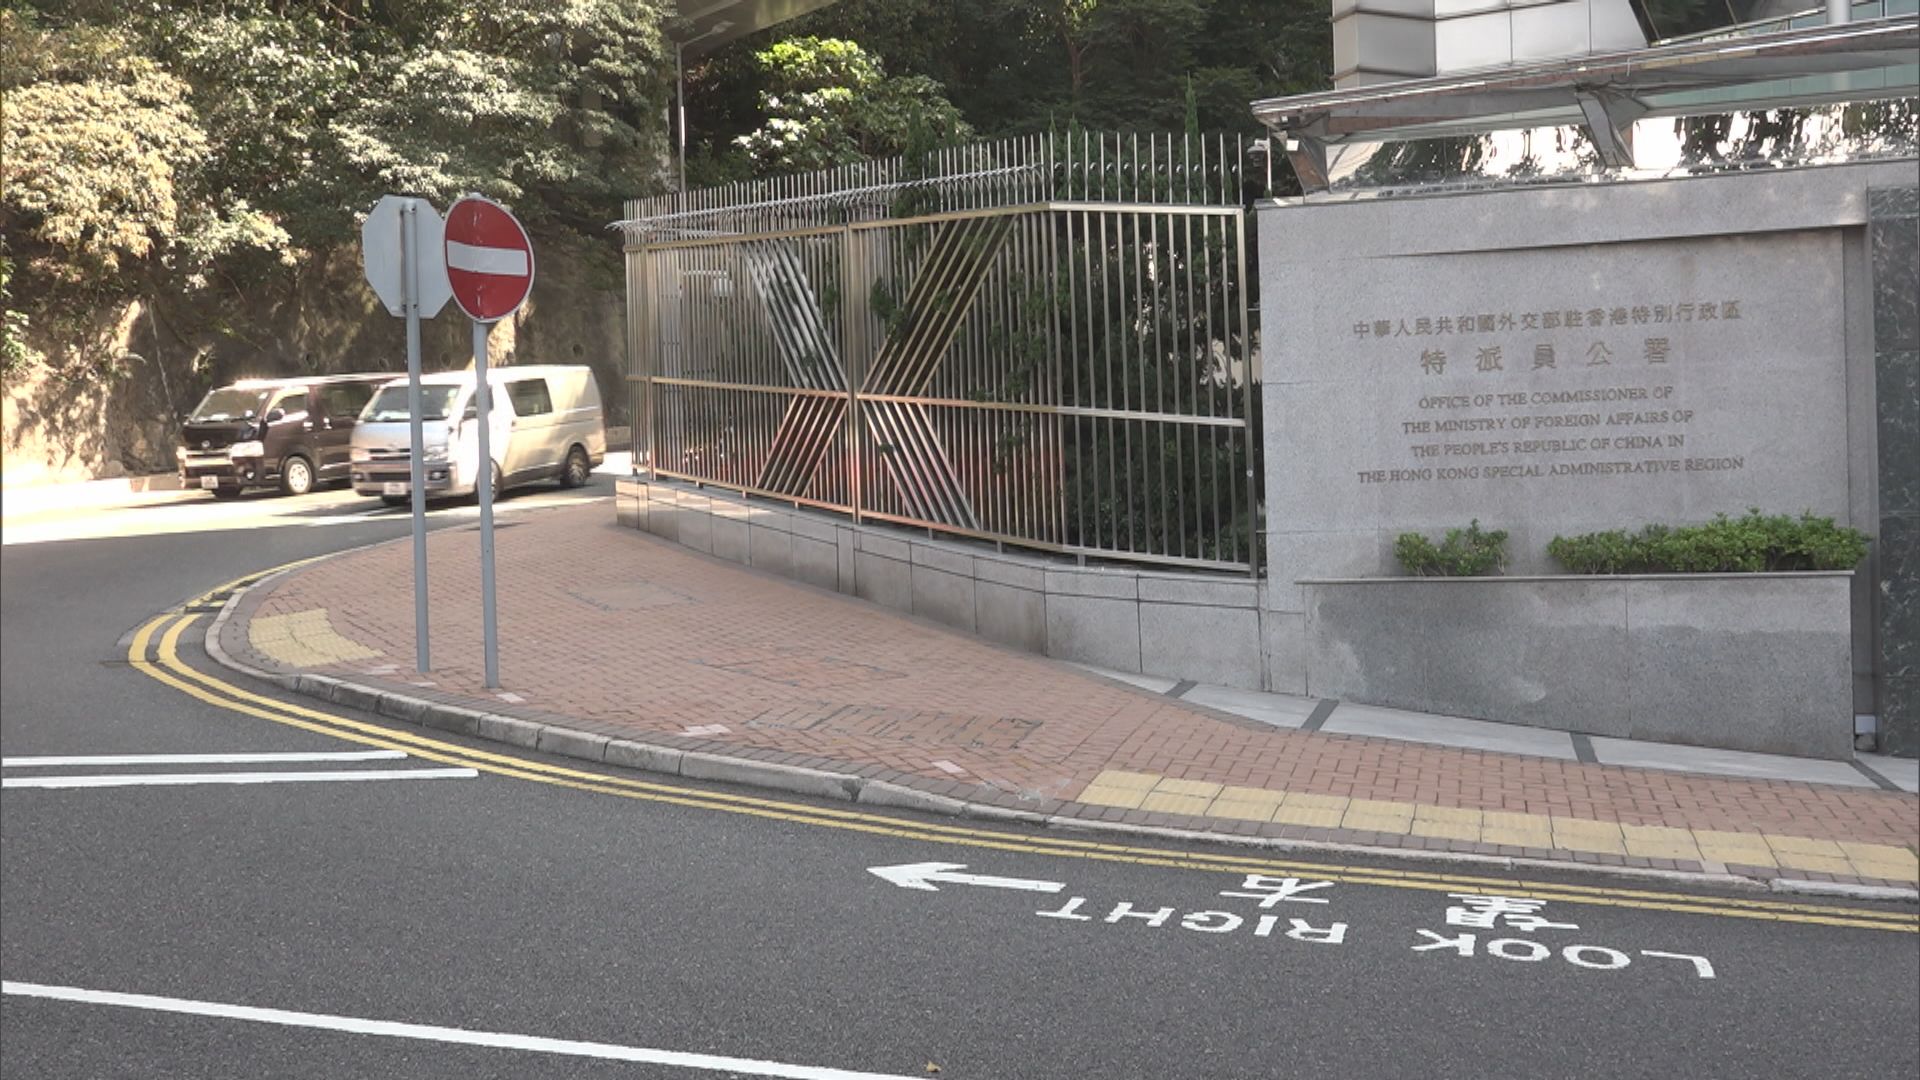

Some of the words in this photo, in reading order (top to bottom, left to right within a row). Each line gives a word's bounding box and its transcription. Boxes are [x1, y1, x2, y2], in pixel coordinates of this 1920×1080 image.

[1420, 338, 1671, 375] 特派員公署
[1419, 395, 1471, 410] OFFICE
[1474, 394, 1494, 407] OF
[1500, 393, 1528, 406] THE
[1531, 387, 1648, 405] COMMISSIONER
[1653, 386, 1673, 399] OF
[1402, 421, 1432, 434] THE
[1435, 417, 1506, 432] MINISTRY
[1511, 416, 1531, 429] OF
[1534, 413, 1601, 429] FOREIGN
[1606, 411, 1669, 426] AFFAIRS
[1672, 410, 1693, 424] OF
[1411, 444, 1440, 457] THE
[1443, 441, 1510, 456] PEOPLE'S
[1514, 438, 1587, 453] REPUBLIC
[1590, 437, 1611, 449] OF
[1614, 435, 1663, 449] CHINA
[1668, 435, 1684, 447] IN
[1358, 470, 1386, 483] THE
[1389, 468, 1433, 482] HONG
[1437, 466, 1479, 480] KONG
[1483, 464, 1543, 478] SPECIAL
[1549, 459, 1680, 477] ADMINISTRATIVE
[1684, 457, 1743, 472] REGION
[1220, 874, 1334, 908] 右
[1036, 897, 1348, 944] RIGHT
[1410, 928, 1716, 979] LOOK
